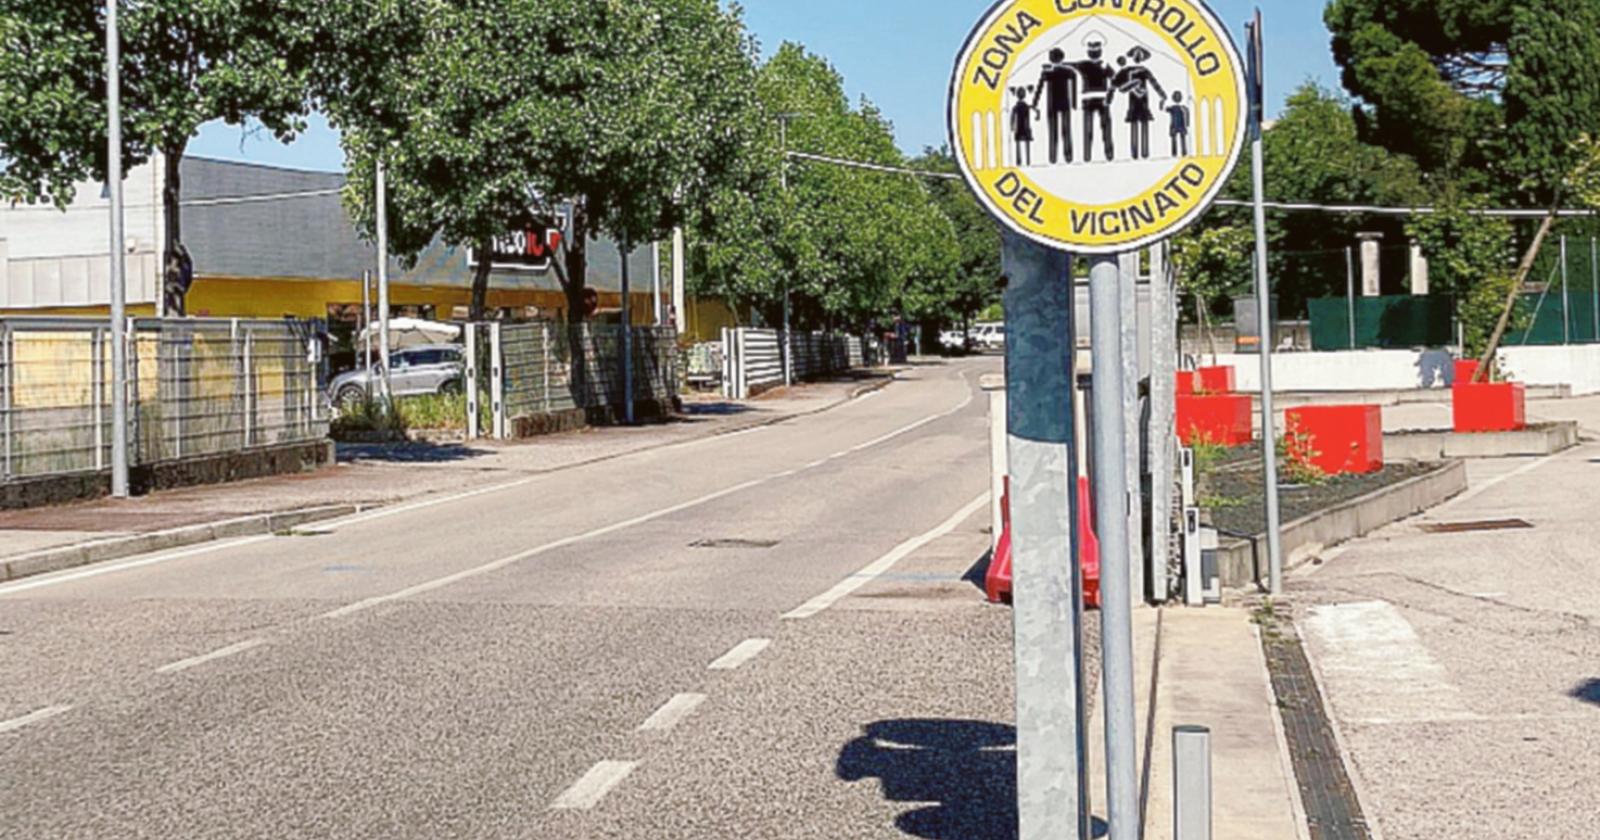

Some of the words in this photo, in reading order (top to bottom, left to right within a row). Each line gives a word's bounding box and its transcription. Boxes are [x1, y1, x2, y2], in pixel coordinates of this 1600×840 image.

[973, 10, 1042, 90] ZONA
[994, 171, 1045, 224] DEL
[1070, 162, 1205, 236] VICINATO
